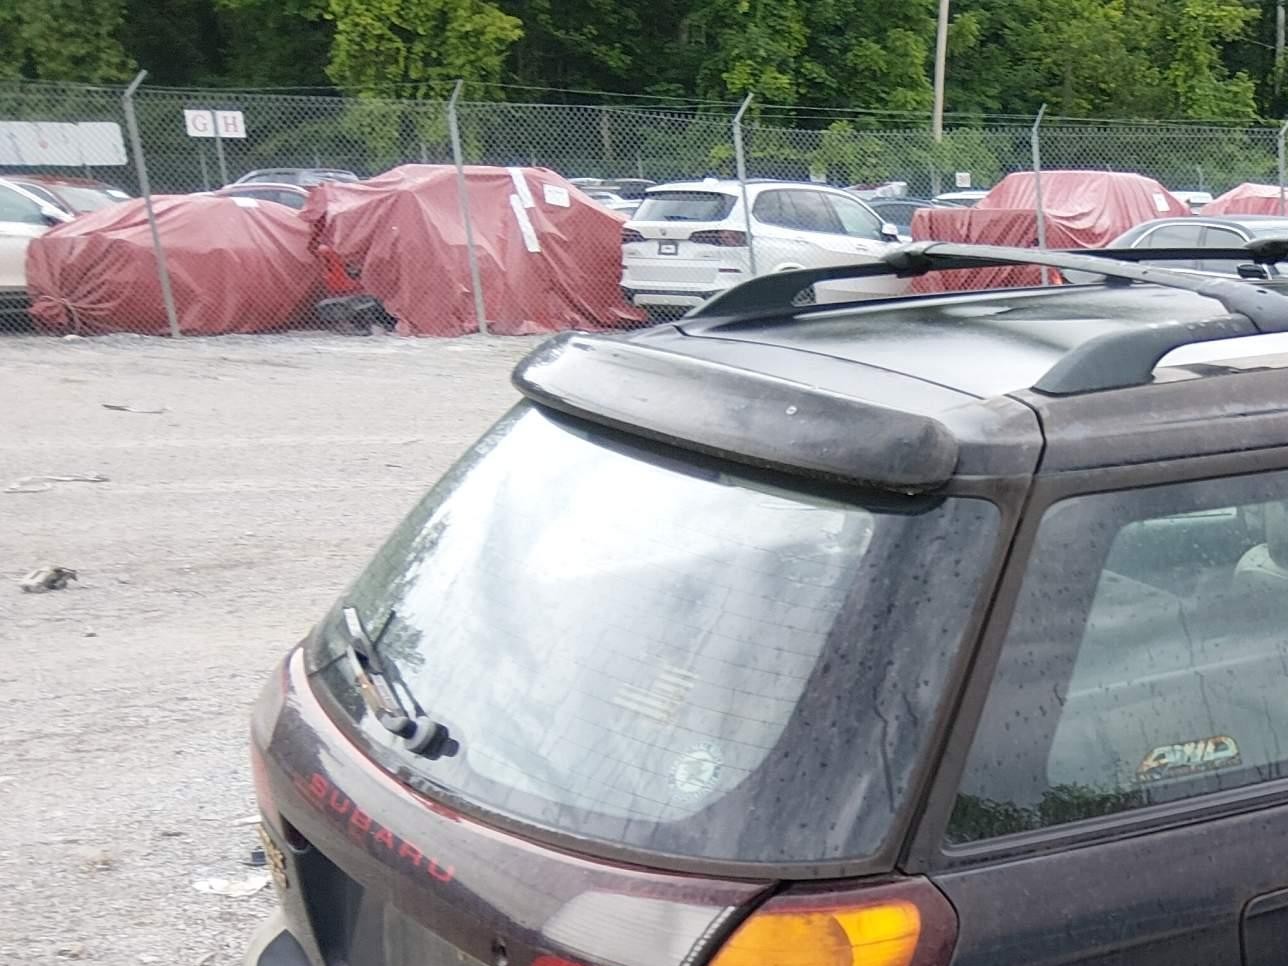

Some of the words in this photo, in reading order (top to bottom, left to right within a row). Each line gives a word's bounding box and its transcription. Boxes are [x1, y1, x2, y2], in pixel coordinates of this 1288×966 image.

[192, 114, 209, 133] G
[223, 115, 240, 133] H
[311, 772, 455, 882] SUBARU
